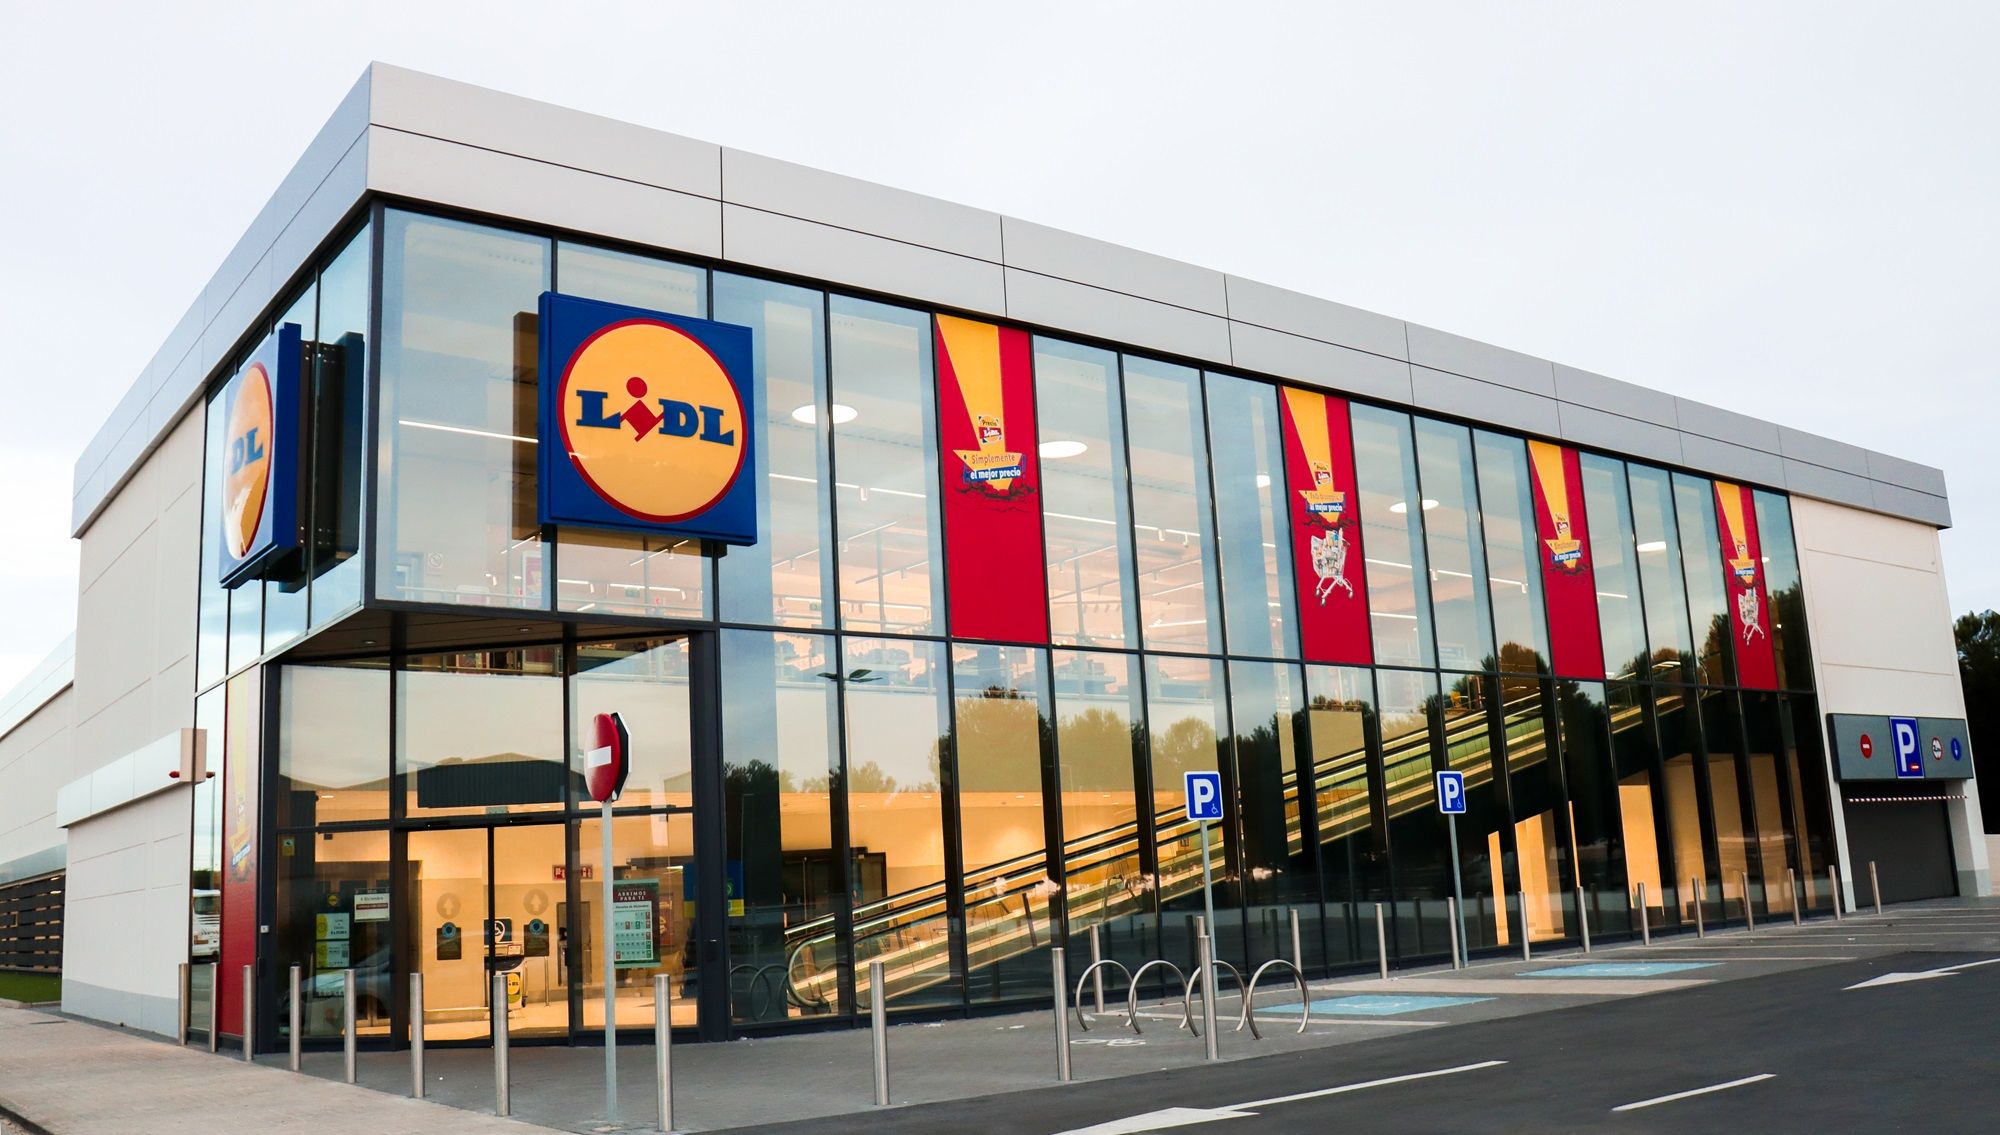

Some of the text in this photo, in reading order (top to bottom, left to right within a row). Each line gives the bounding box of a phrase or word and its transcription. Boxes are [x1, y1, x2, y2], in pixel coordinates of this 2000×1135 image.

[970, 466, 1021, 481] el mejor precio
[971, 454, 1016, 466] Simplemente
[1896, 723, 1915, 772] P
[1193, 779, 1214, 814] P
[1444, 777, 1459, 808] P
